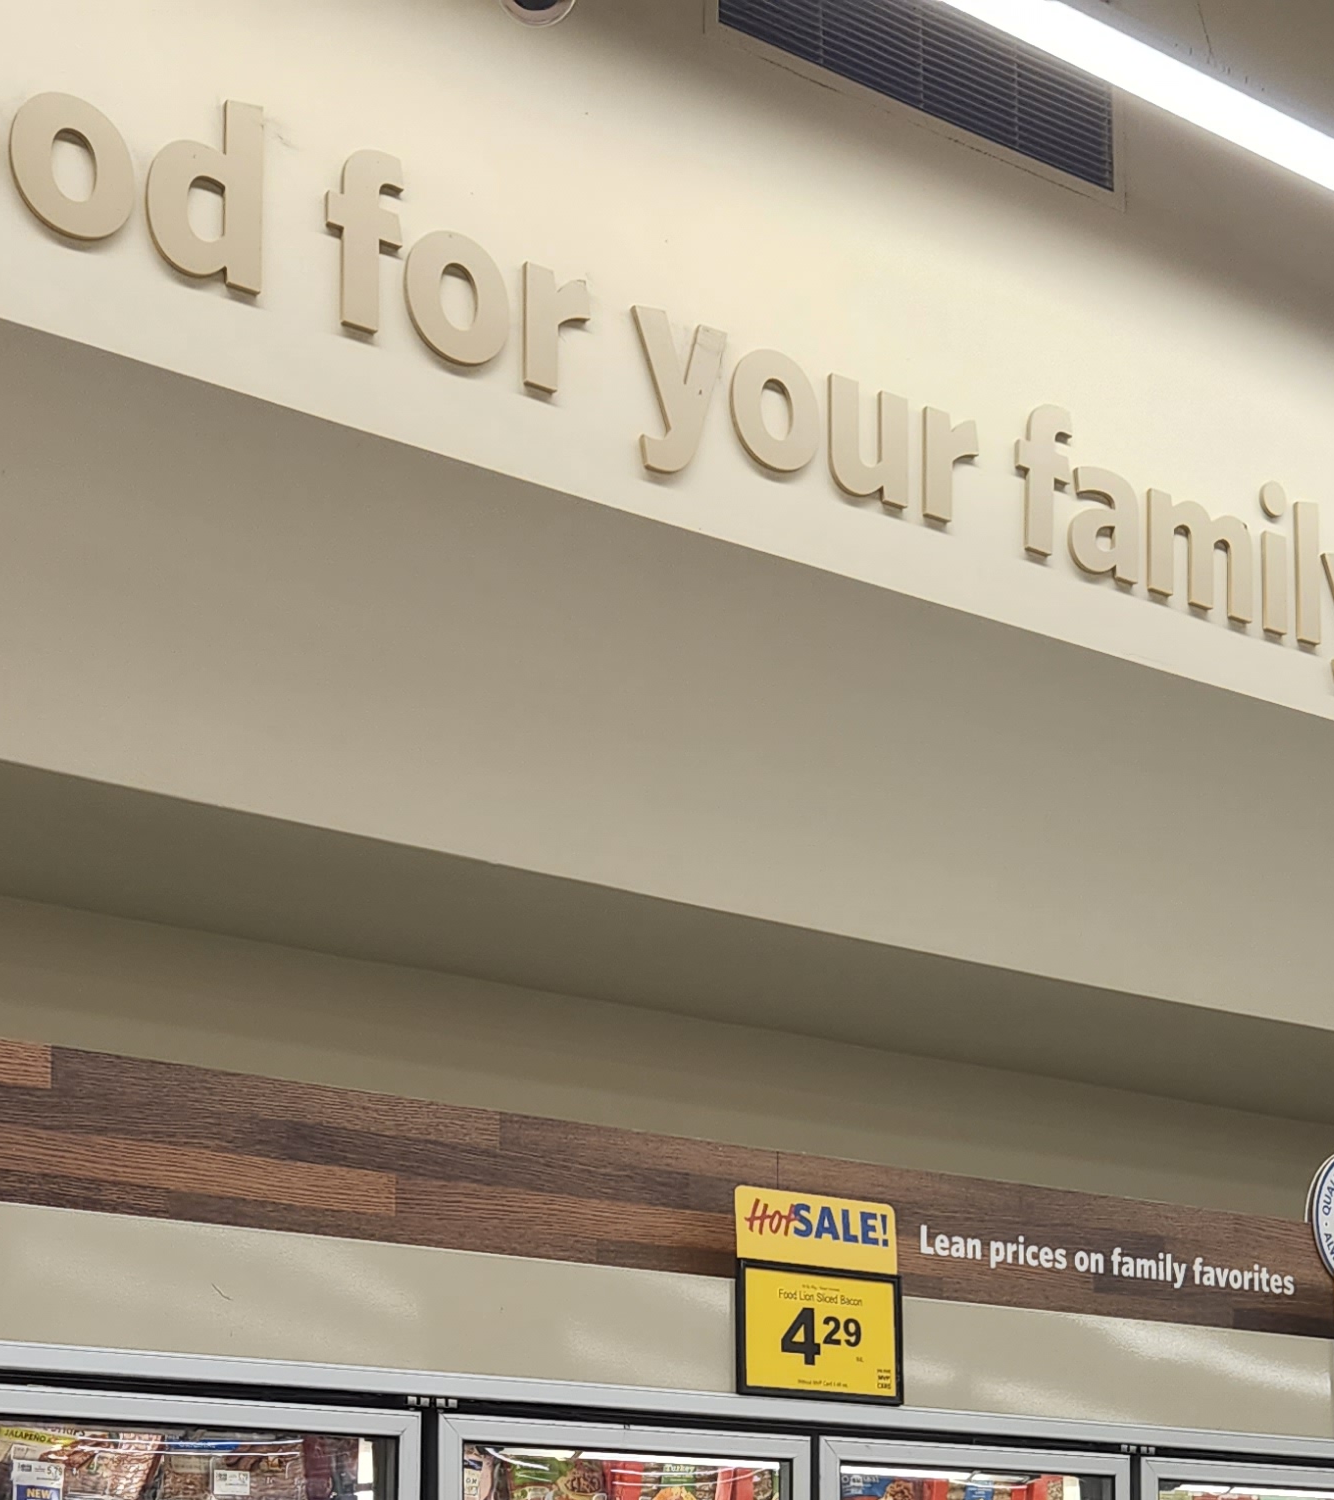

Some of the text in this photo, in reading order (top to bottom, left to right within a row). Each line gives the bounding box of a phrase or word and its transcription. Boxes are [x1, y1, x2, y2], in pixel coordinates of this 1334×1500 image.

[323, 148, 591, 396] for
[629, 303, 979, 526] your
[919, 1224, 1295, 1296] Lean prices on family favorites
[778, 1288, 862, 1306] Food Lion Sliced Bacon
[26, 1488, 51, 1499] NEW
